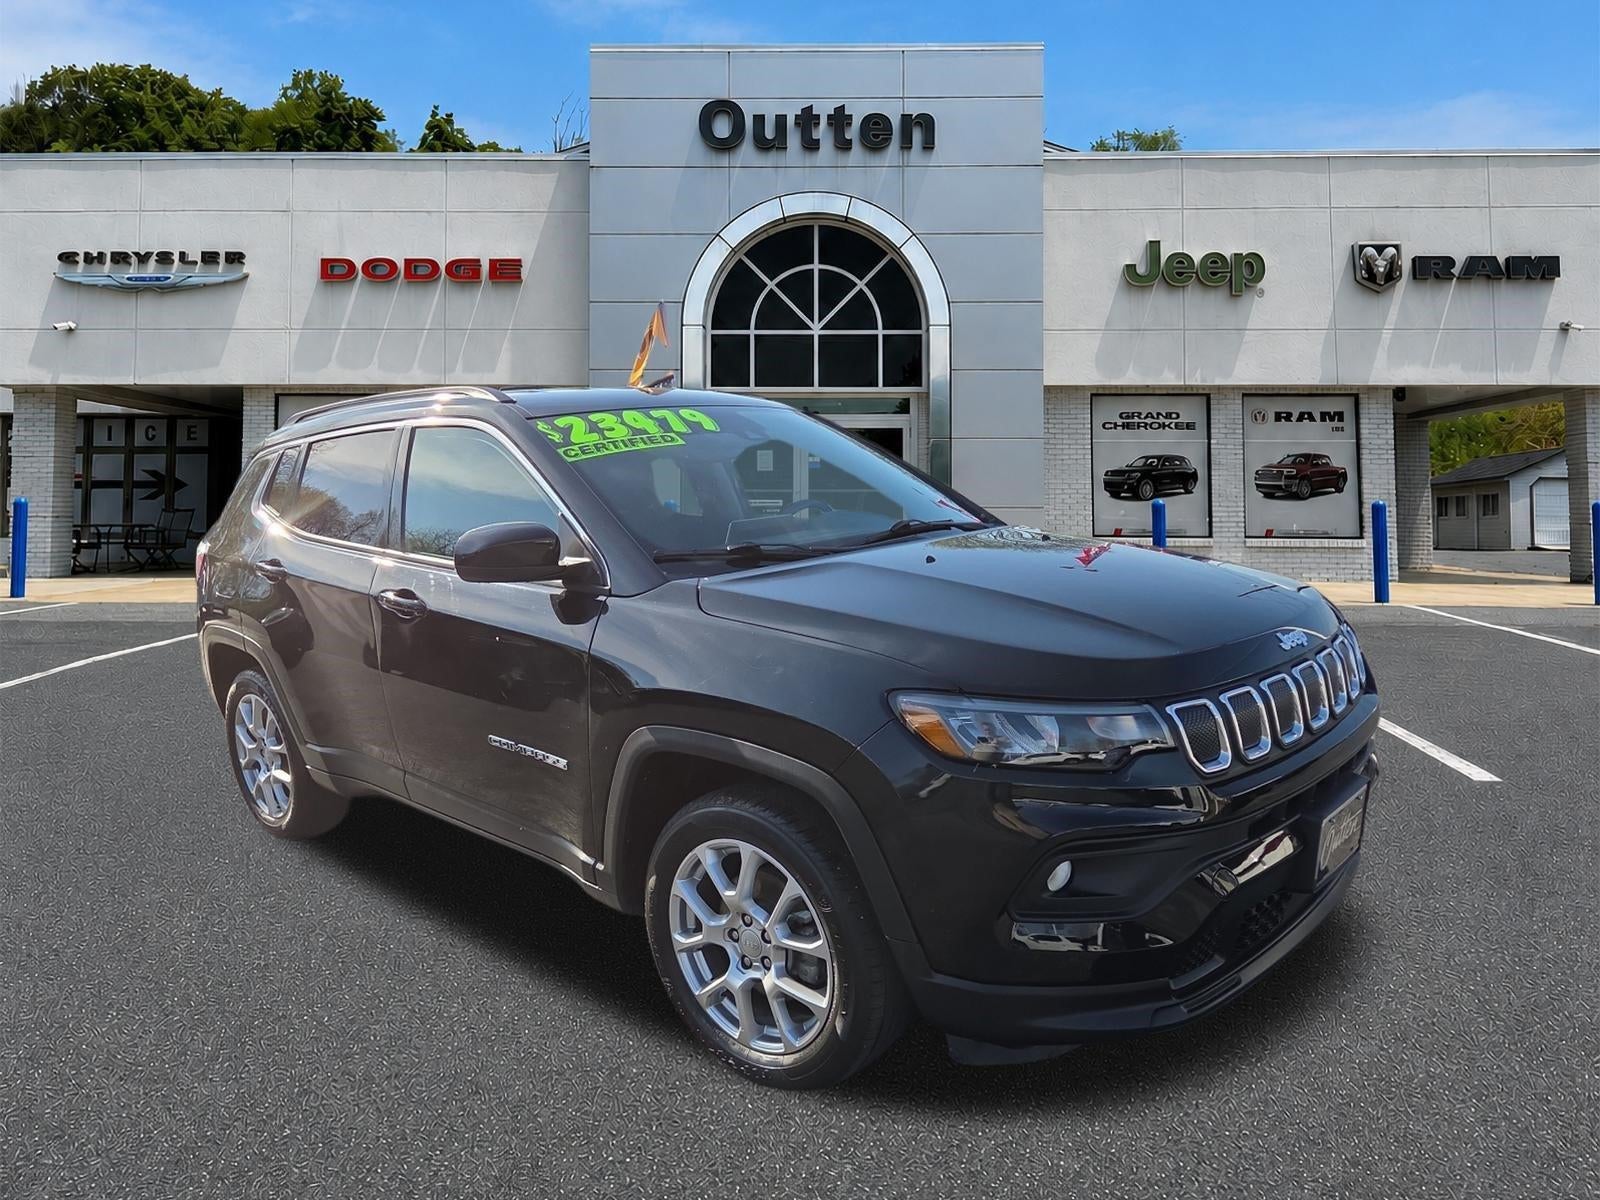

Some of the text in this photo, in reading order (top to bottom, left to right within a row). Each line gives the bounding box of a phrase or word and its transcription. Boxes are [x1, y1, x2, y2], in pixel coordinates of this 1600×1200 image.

[698, 99, 935, 150] Outten
[57, 251, 246, 265] CHRYSLER
[319, 257, 523, 282] DODGE
[1123, 240, 1266, 296] Jeep
[1411, 255, 1561, 280] RAM
[535, 408, 721, 445] $23479
[1101, 422, 1196, 431] CHEROKEE
[1119, 411, 1180, 420] GRAND
[1274, 411, 1345, 422] RAM
[562, 434, 677, 458] CERTIFIED
